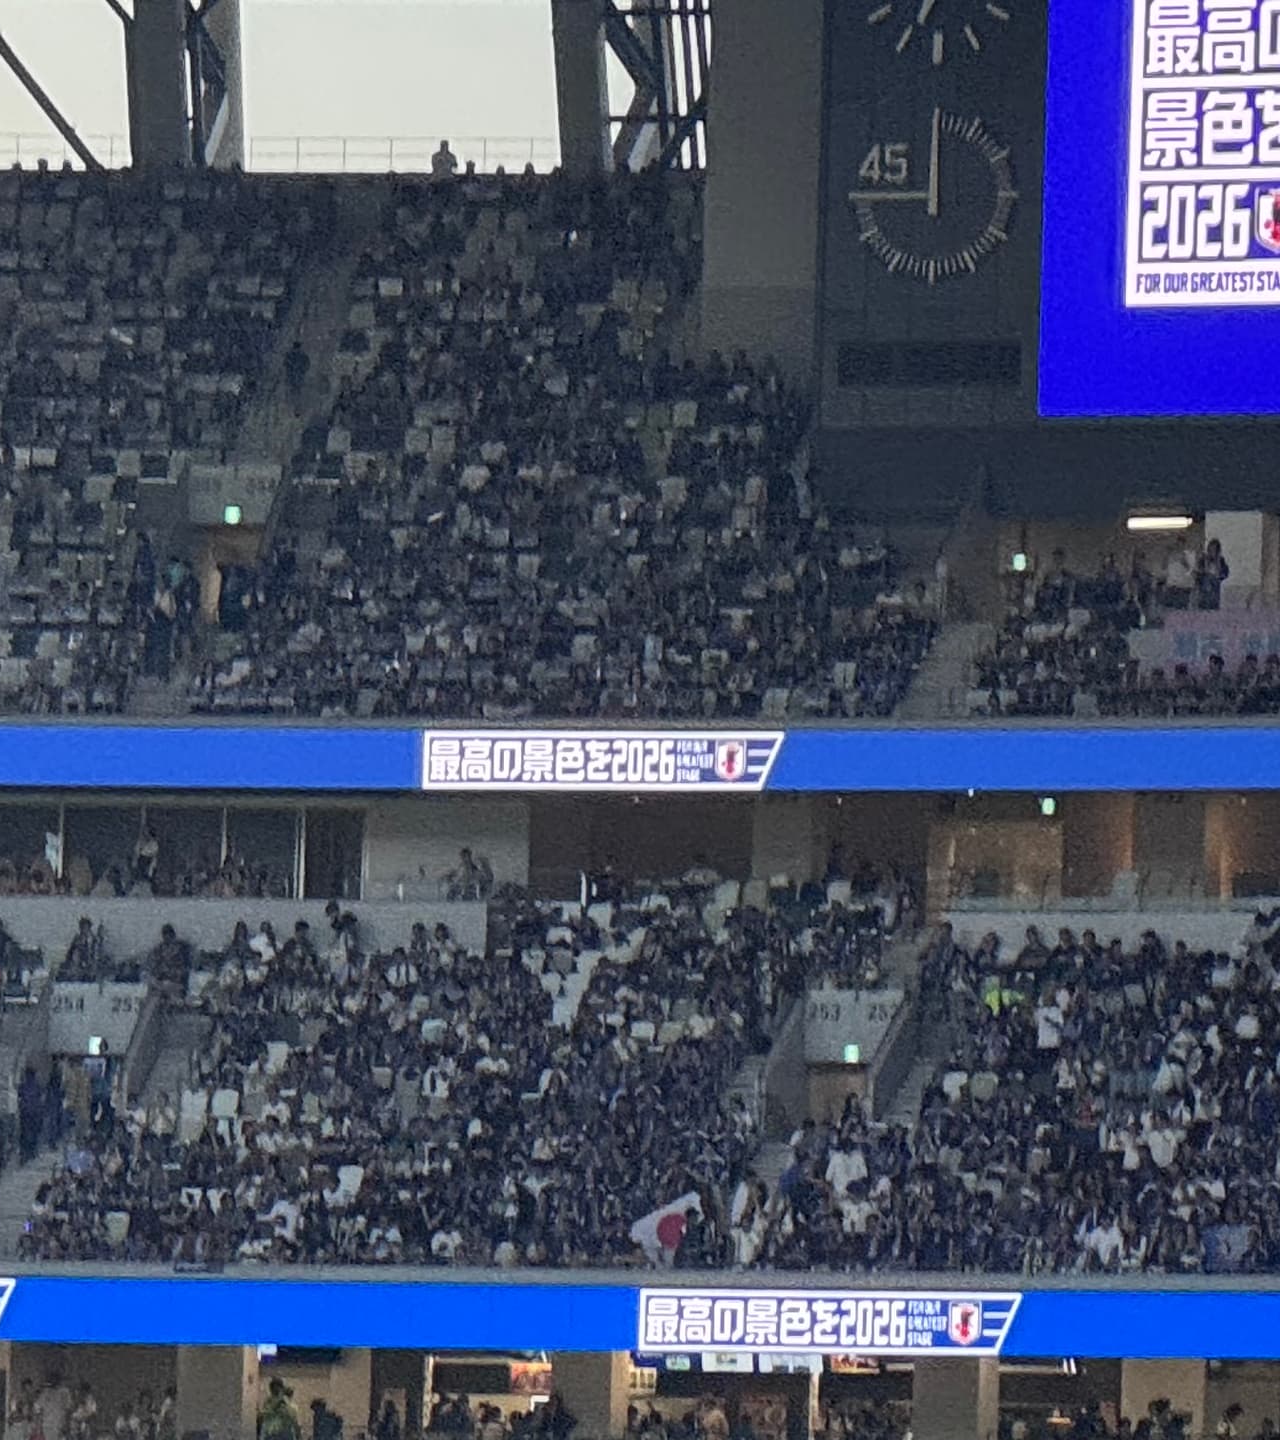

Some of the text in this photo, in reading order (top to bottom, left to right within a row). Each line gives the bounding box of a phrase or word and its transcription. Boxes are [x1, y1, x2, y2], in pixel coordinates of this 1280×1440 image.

[860, 143, 909, 184] 45
[1141, 183, 1252, 260] 2026
[1136, 273, 1161, 294] FOR
[1163, 273, 1188, 293] OUR
[1190, 272, 1255, 293] GREATEST
[431, 739, 674, 782] 最高の景色を2026
[646, 1298, 906, 1345] 最高の景色を2026
